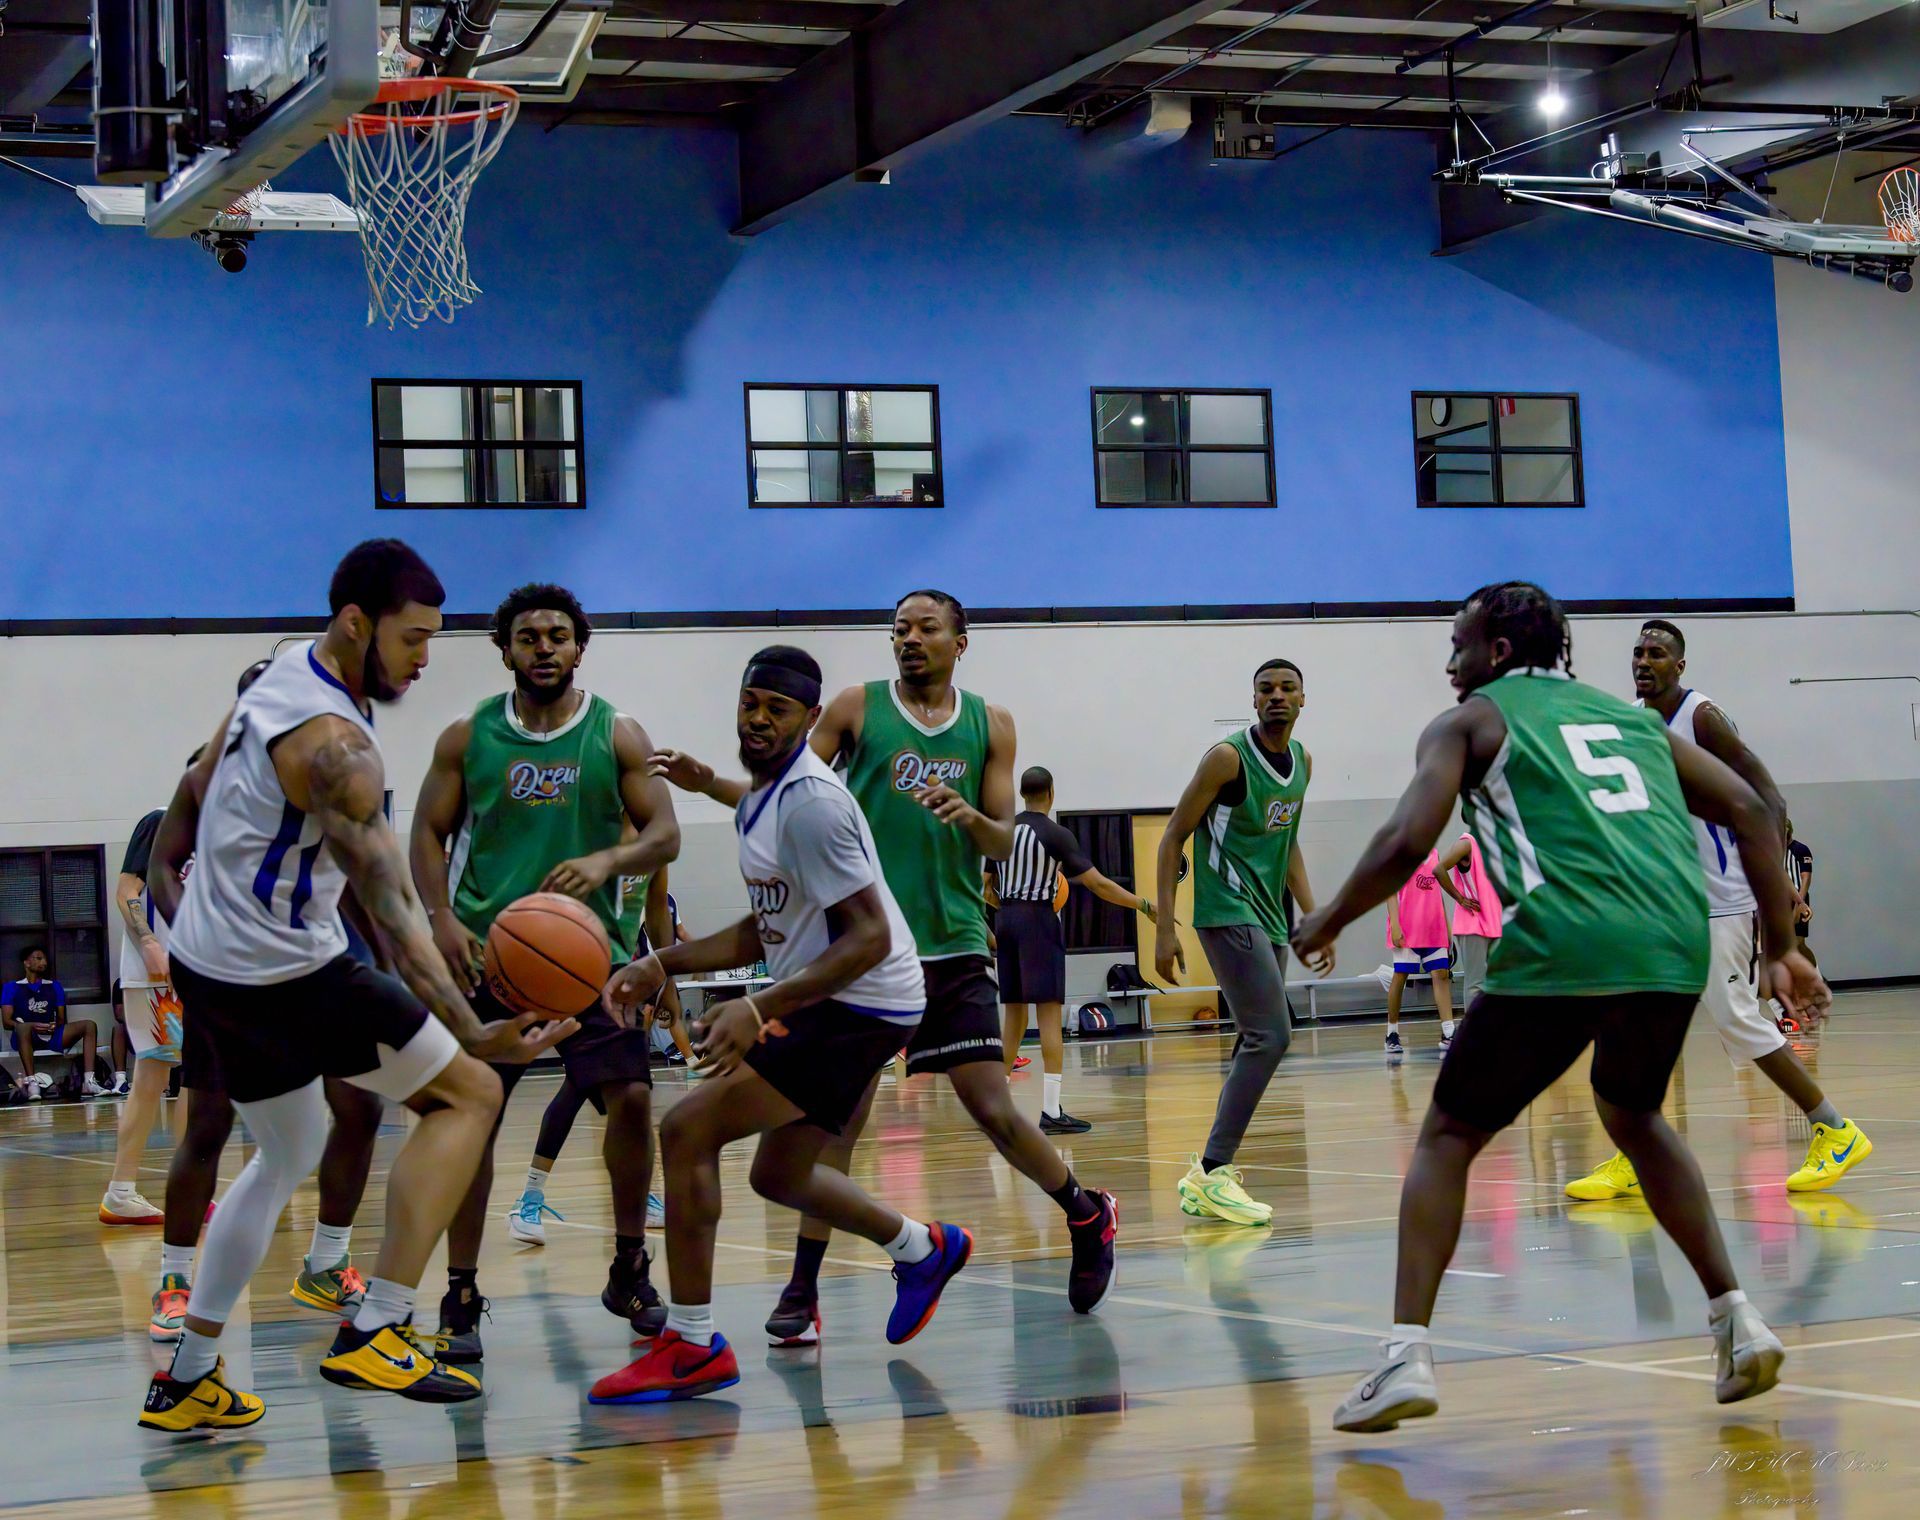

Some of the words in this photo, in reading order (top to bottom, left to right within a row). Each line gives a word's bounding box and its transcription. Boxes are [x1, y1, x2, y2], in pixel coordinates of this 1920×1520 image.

[509, 762, 580, 799] Drew
[895, 752, 967, 791] Drew
[1558, 723, 1651, 813] 5
